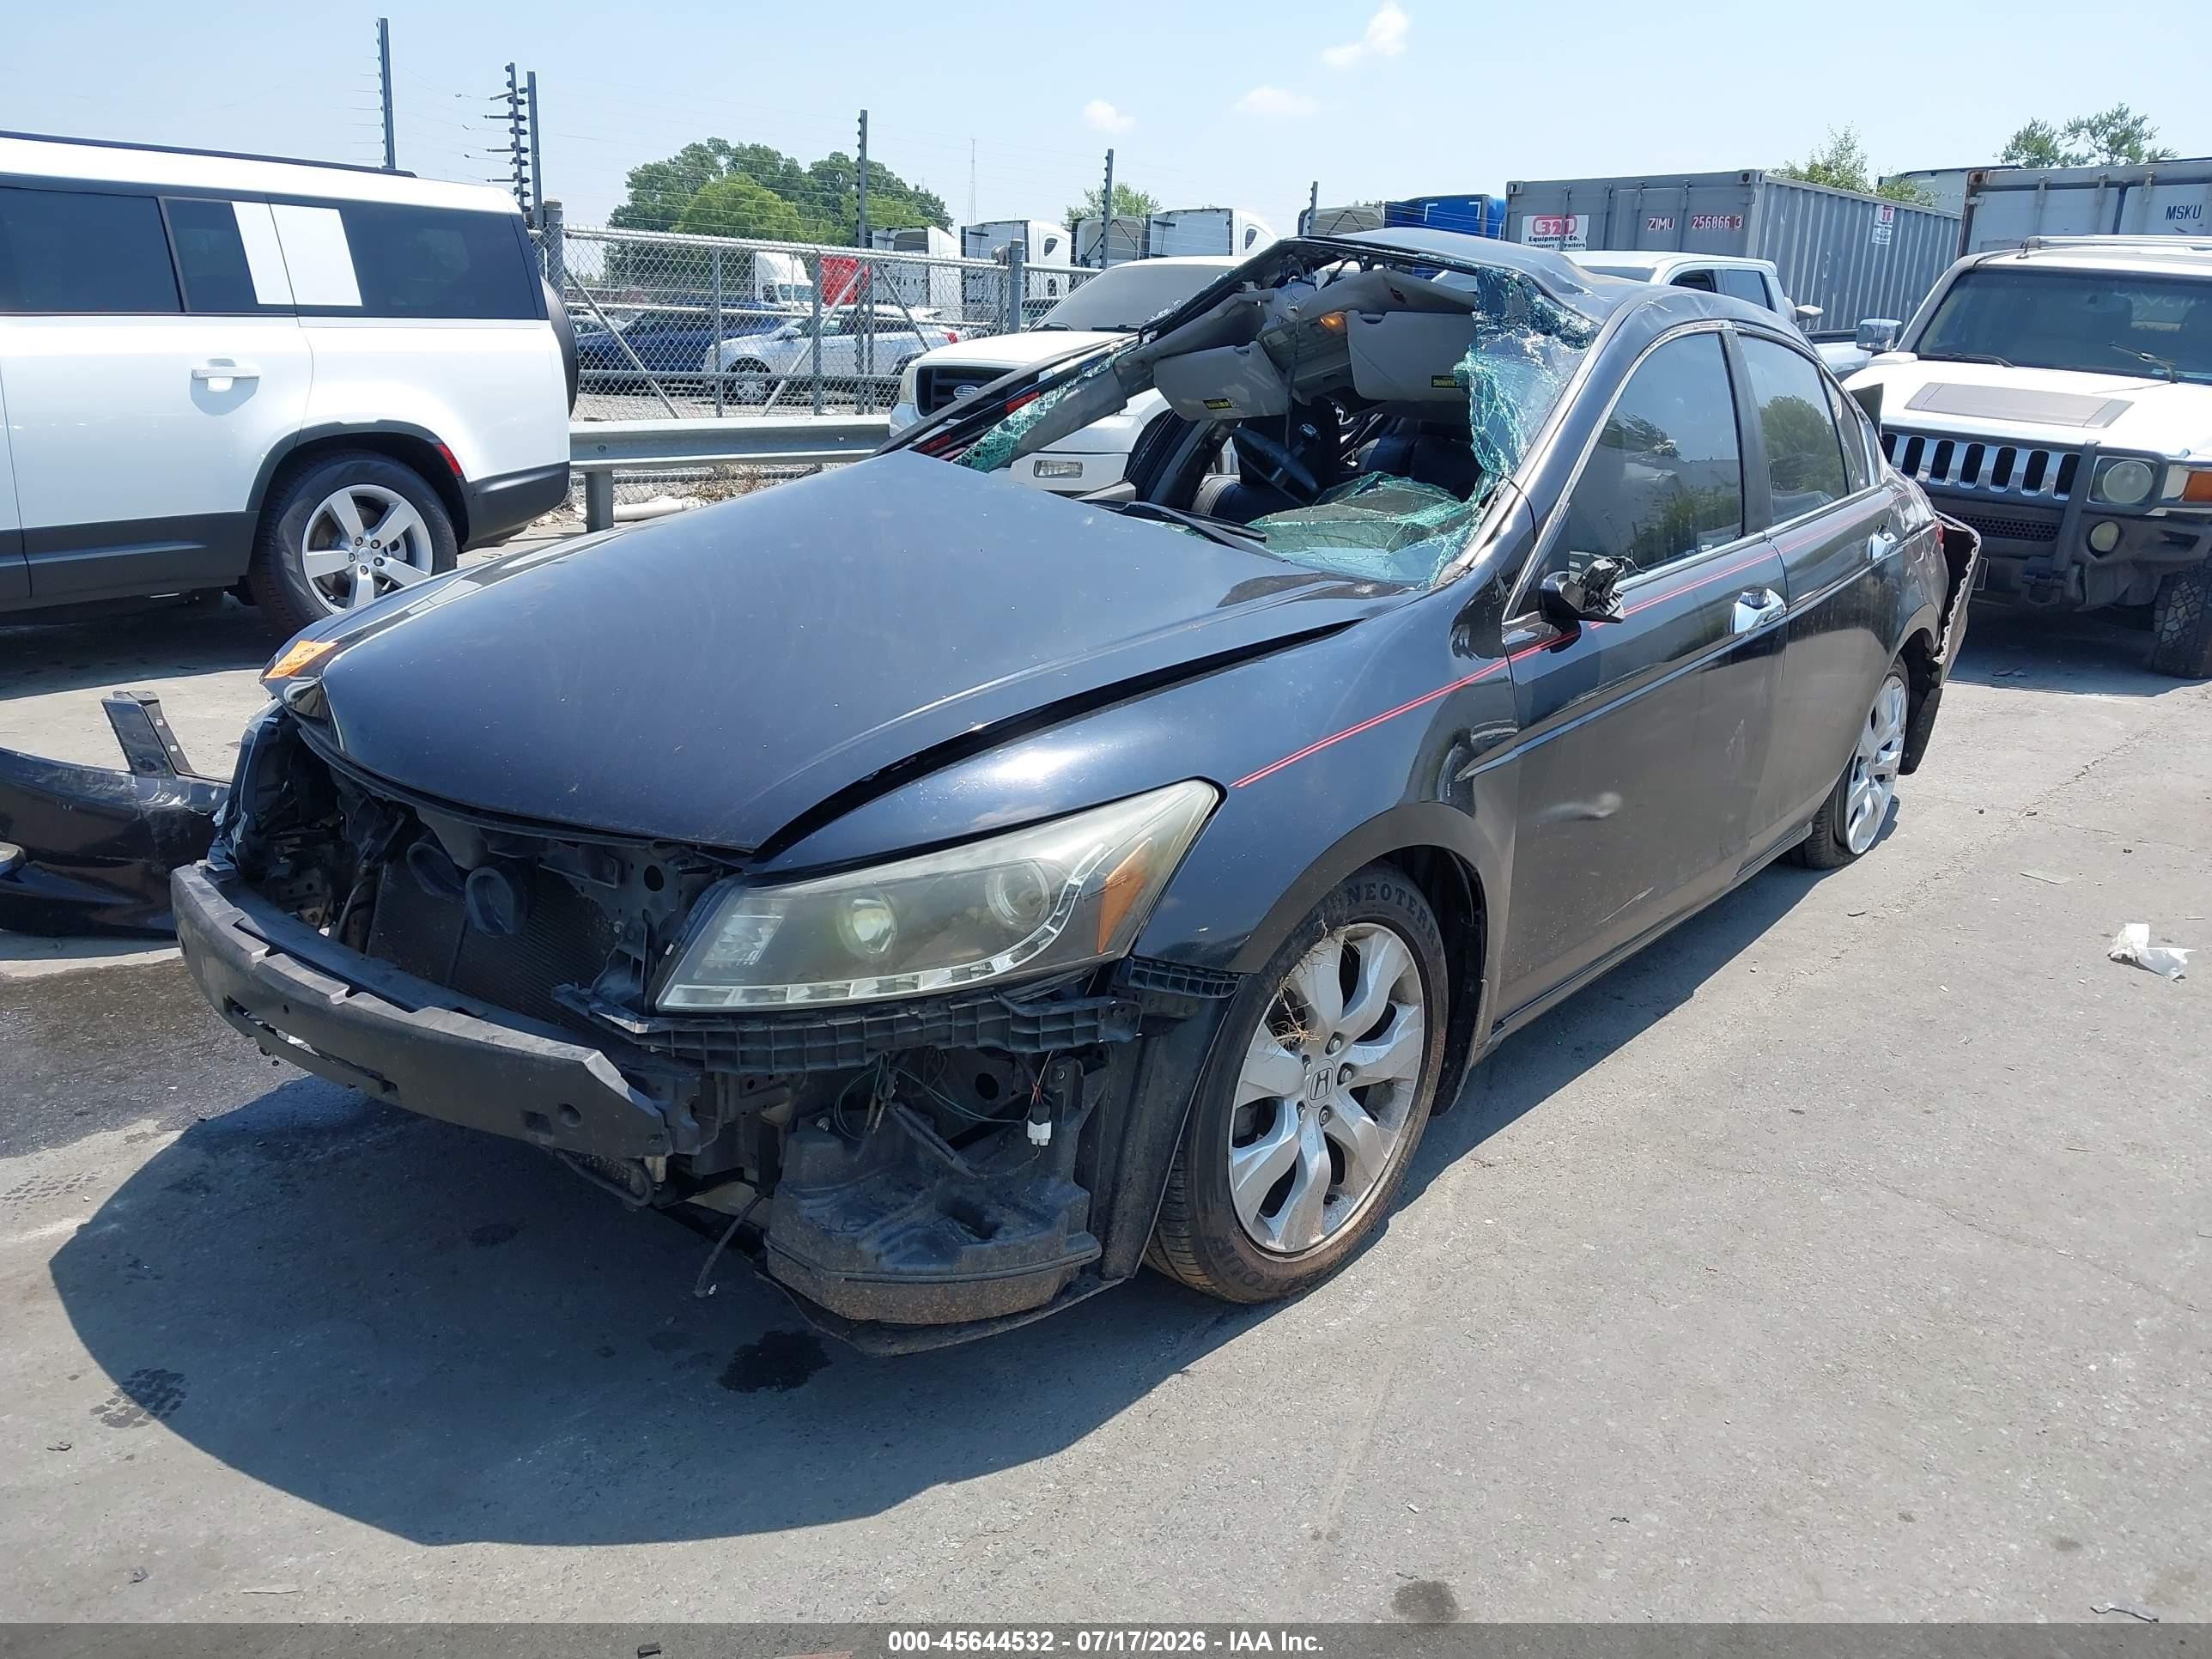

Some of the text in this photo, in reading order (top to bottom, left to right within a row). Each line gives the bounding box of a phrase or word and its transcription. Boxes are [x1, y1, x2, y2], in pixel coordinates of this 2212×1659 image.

[2165, 204, 2203, 221] MSKU
[1648, 216, 1743, 231] ZIMU 256866 3
